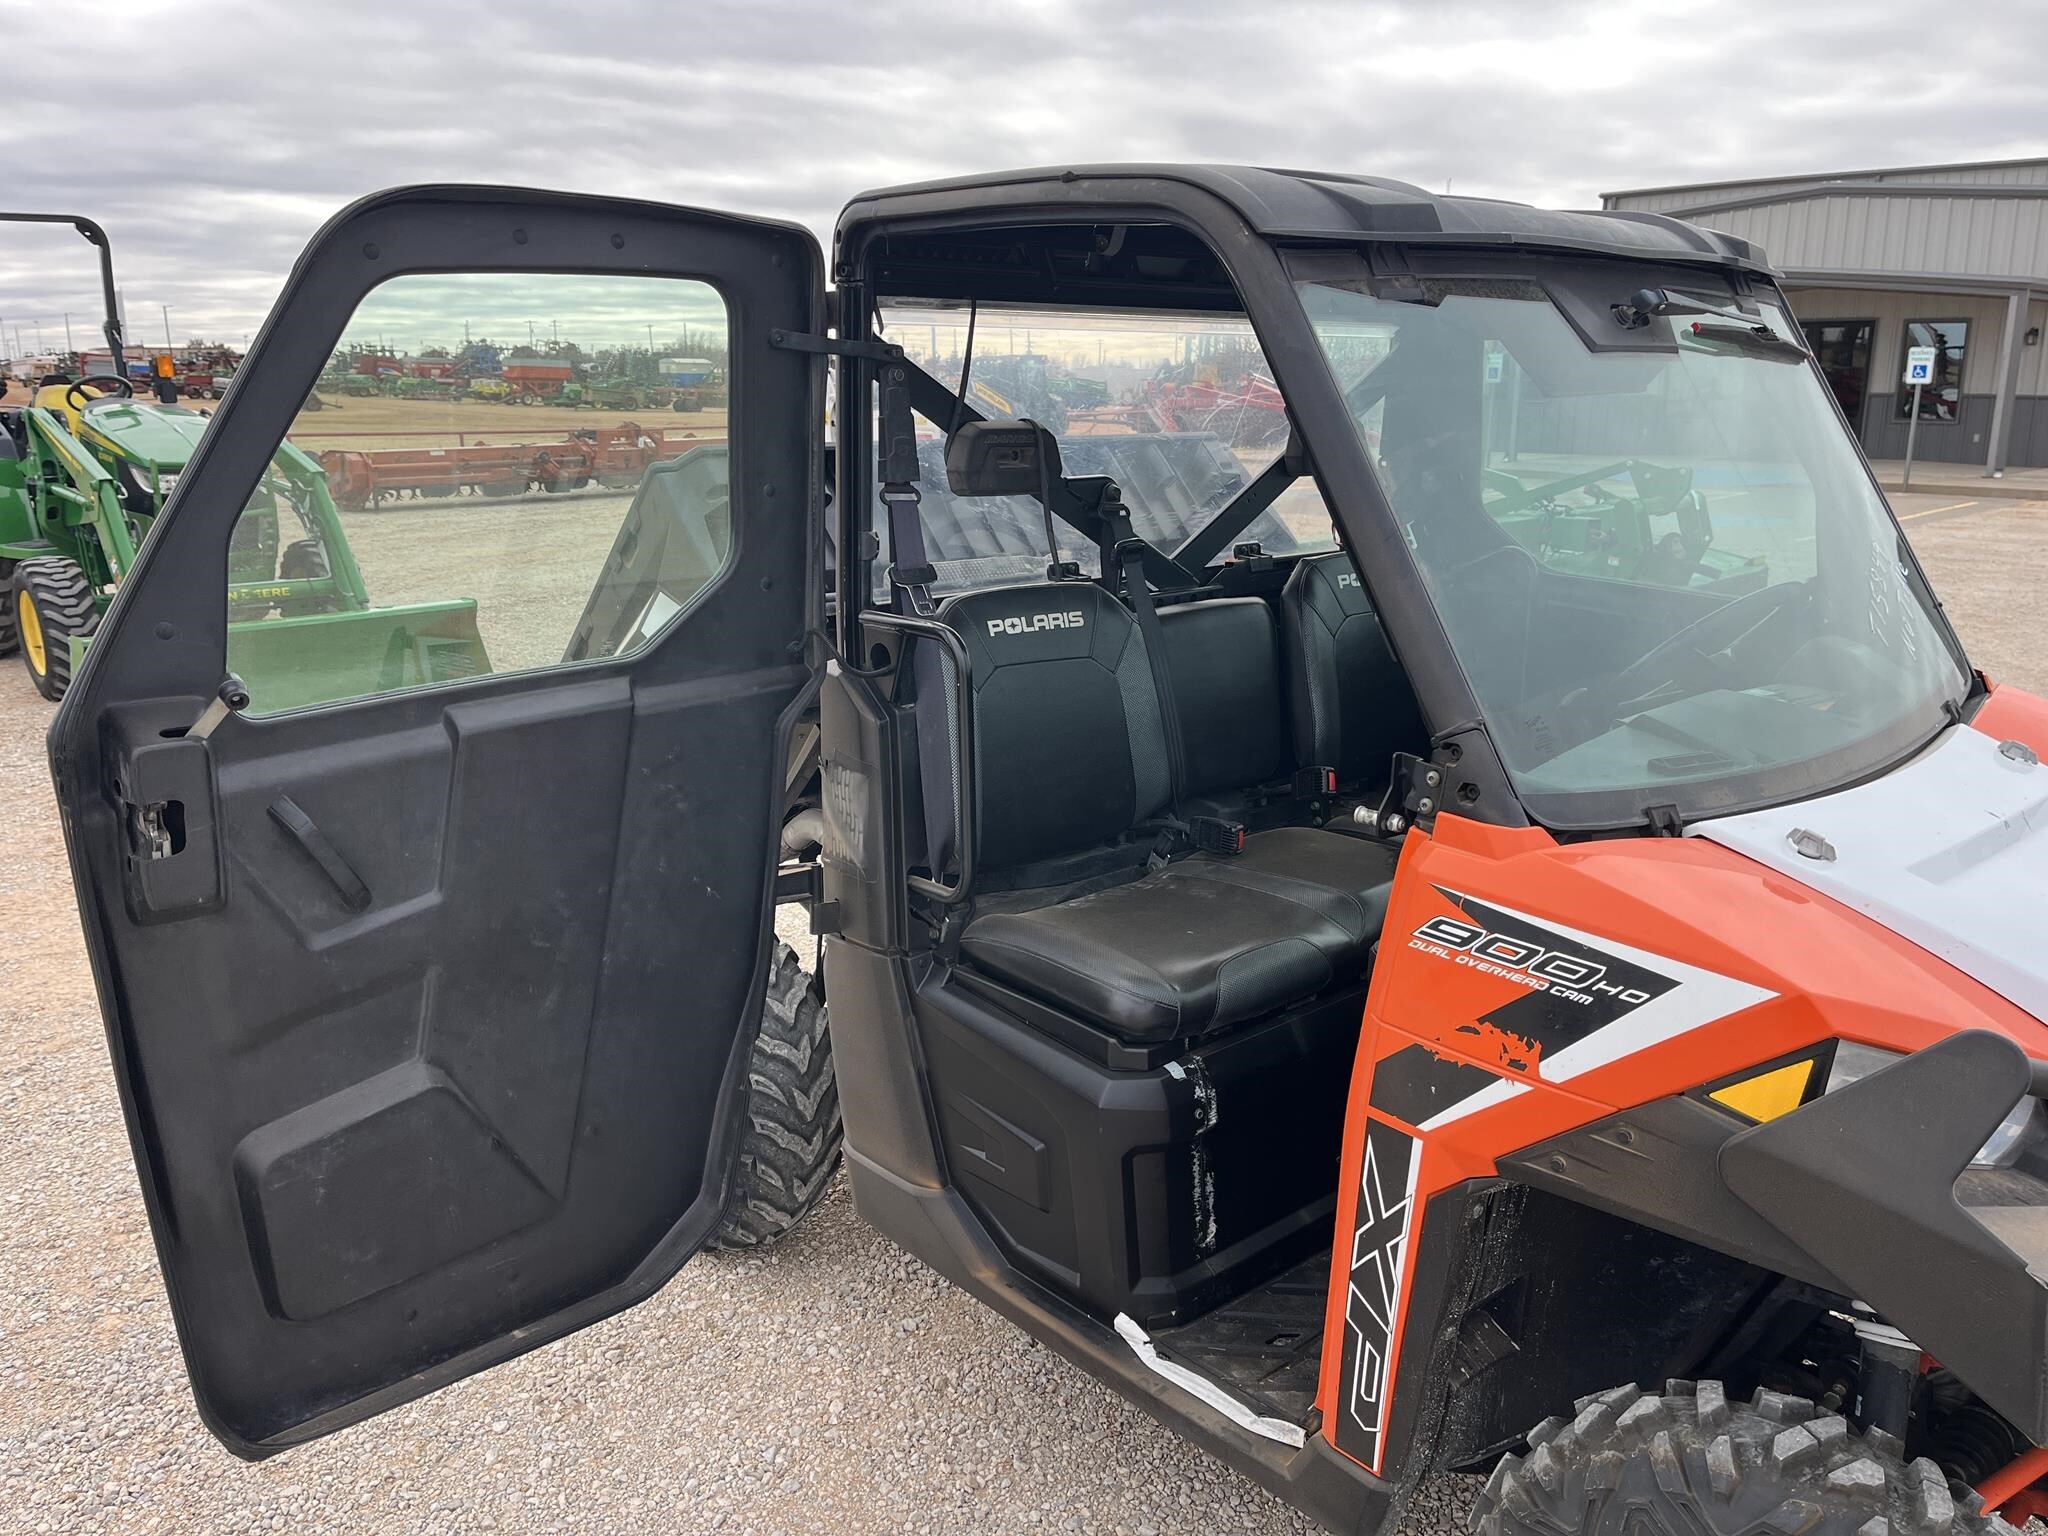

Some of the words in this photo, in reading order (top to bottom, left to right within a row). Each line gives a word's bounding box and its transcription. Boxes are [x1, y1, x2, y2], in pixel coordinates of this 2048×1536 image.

[984, 434, 1040, 445] RANGE
[987, 611, 1085, 637] POLARIS
[1408, 939, 1451, 960] DUAL
[1454, 955, 1551, 991] OVERHEAD
[1550, 985, 1594, 1005] CAM
[1412, 915, 1607, 988] 900
[1592, 980, 1650, 1004] HO
[1346, 1133, 1413, 1431] XP
